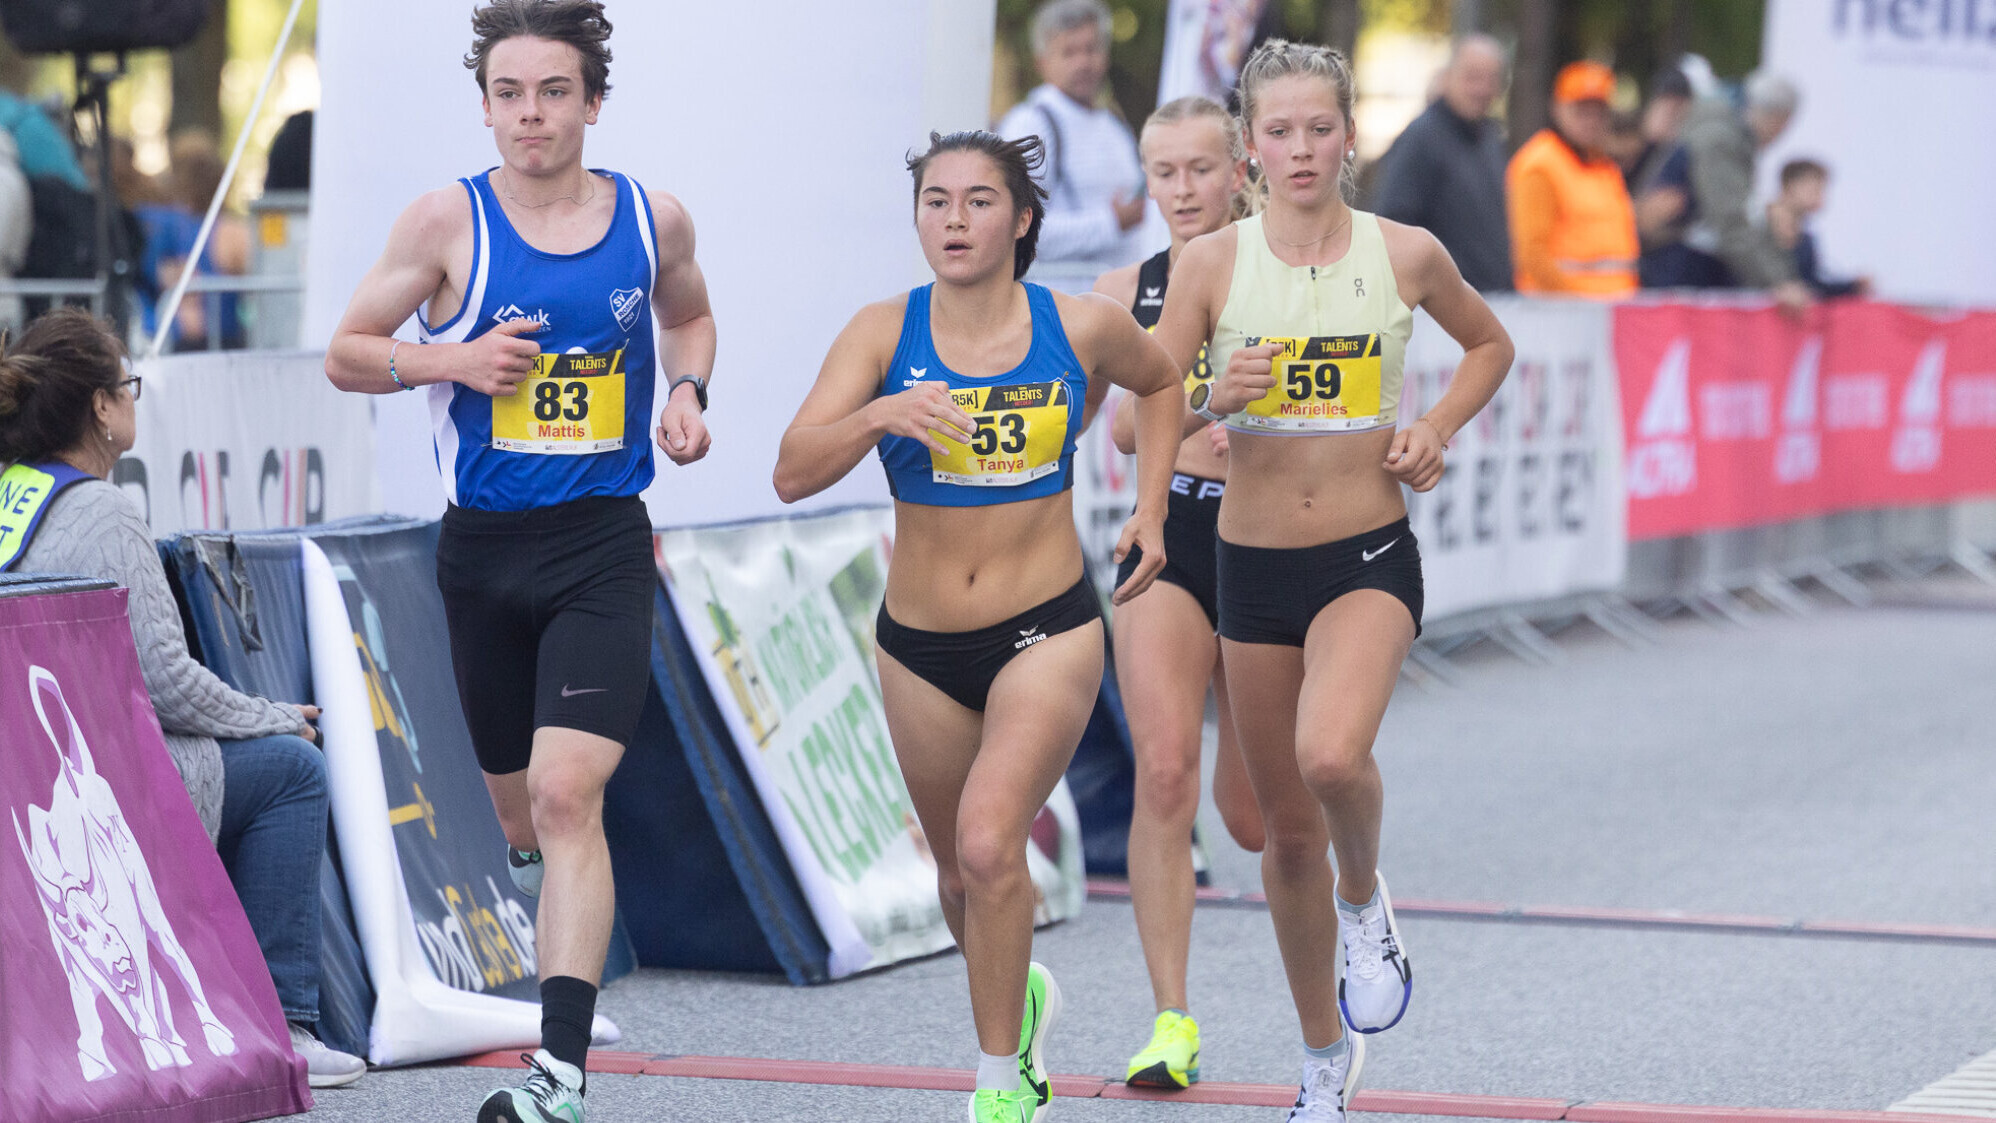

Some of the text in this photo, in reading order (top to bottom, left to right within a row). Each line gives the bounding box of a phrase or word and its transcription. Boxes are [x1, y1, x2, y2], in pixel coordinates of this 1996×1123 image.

[613, 293, 626, 307] SV
[618, 293, 640, 318] ROSCHE
[1321, 340, 1359, 353] TALENTS
[570, 358, 607, 370] TALENTS
[1287, 363, 1341, 401] 59
[534, 381, 588, 421] 83
[1003, 388, 1043, 403] TALENTS
[1280, 402, 1348, 416] Marielies
[538, 425, 585, 438] Mattis
[971, 413, 1027, 456] 53
[976, 458, 1024, 474] Tanya
[1014, 633, 1048, 649] erima
